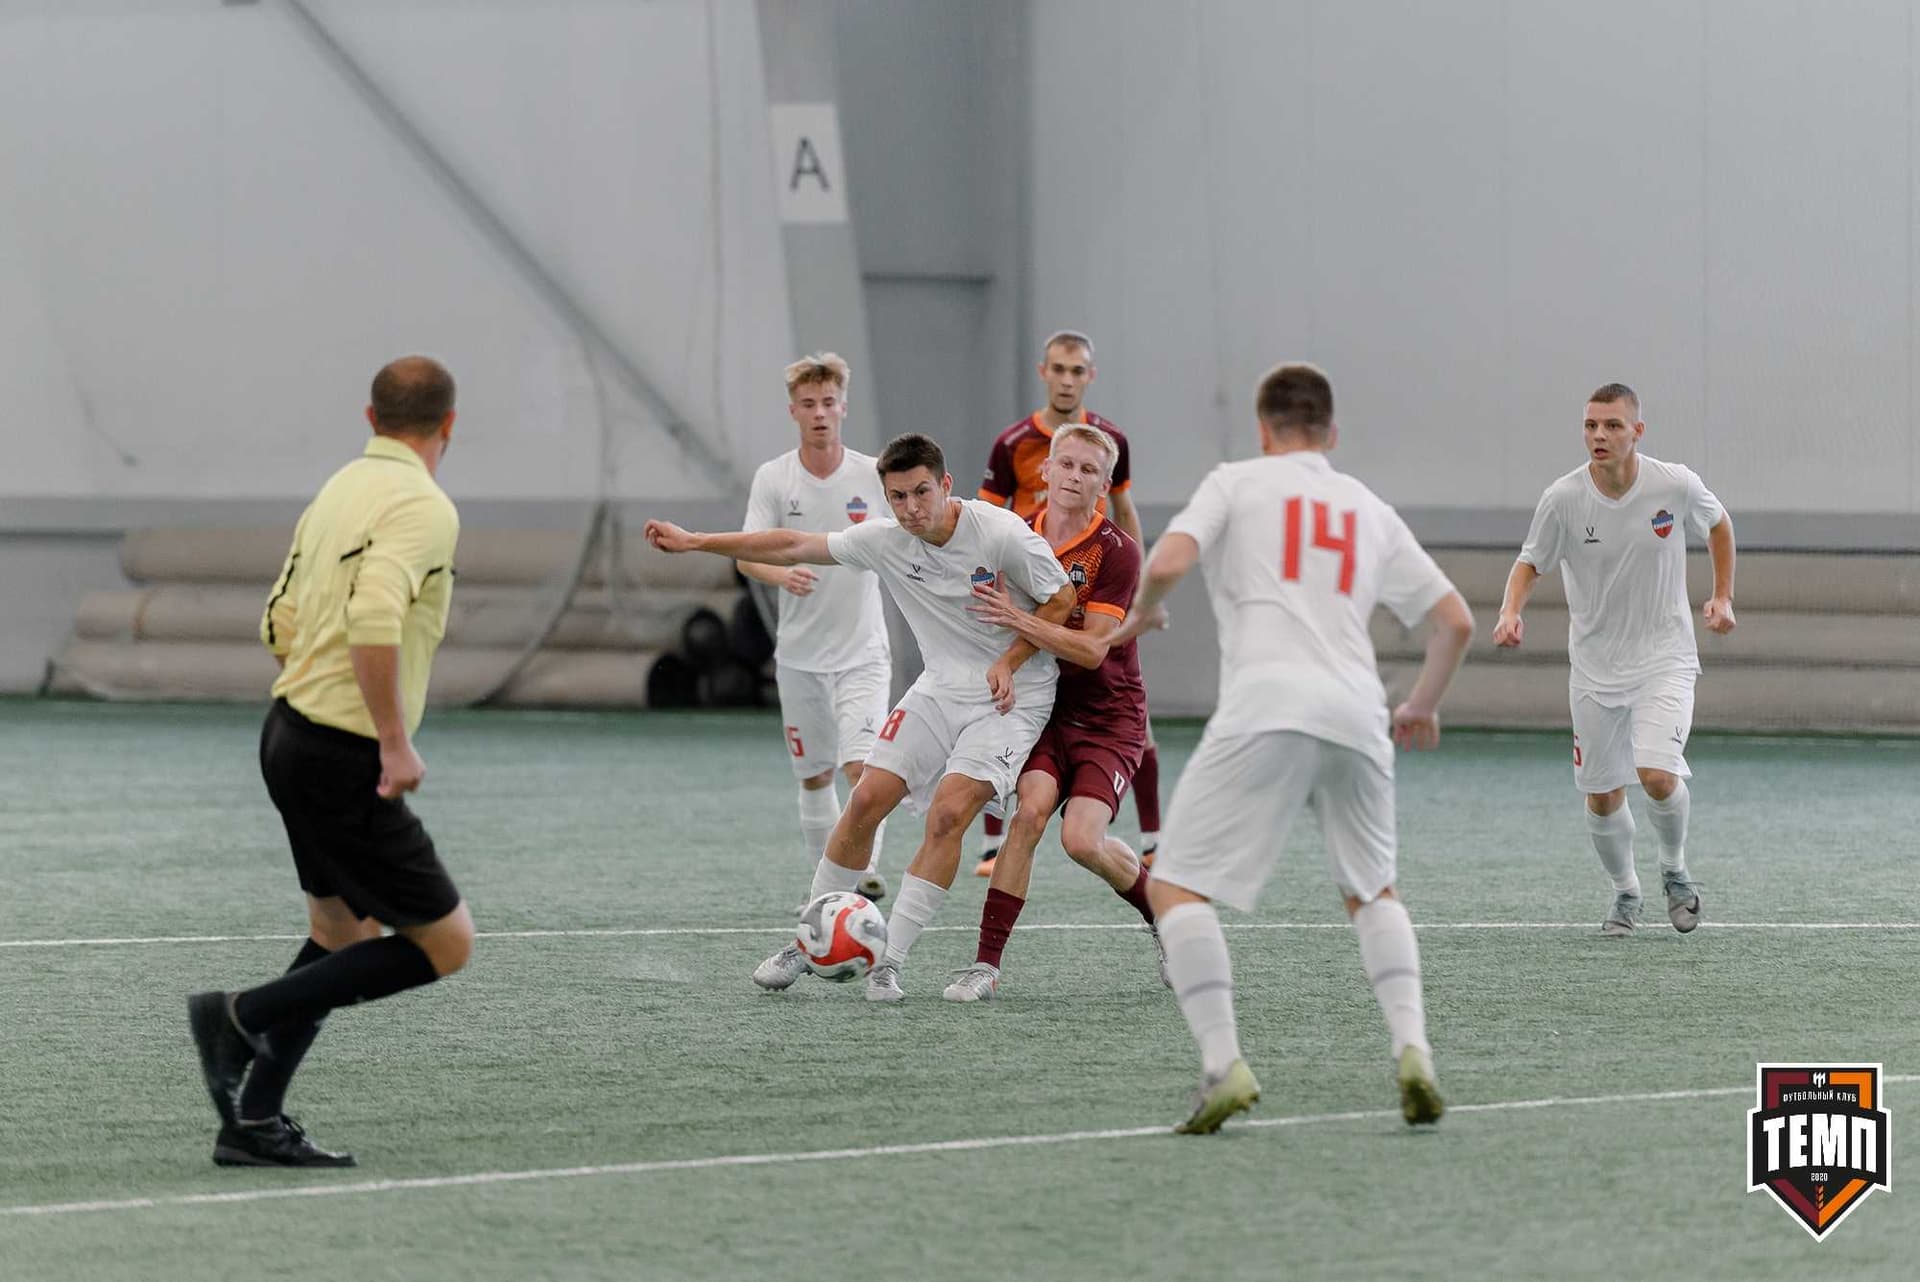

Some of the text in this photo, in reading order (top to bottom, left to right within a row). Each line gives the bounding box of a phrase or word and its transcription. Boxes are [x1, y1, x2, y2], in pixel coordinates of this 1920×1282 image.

[789, 136, 831, 192] A
[1282, 496, 1356, 596] 14
[879, 709, 906, 742] 8
